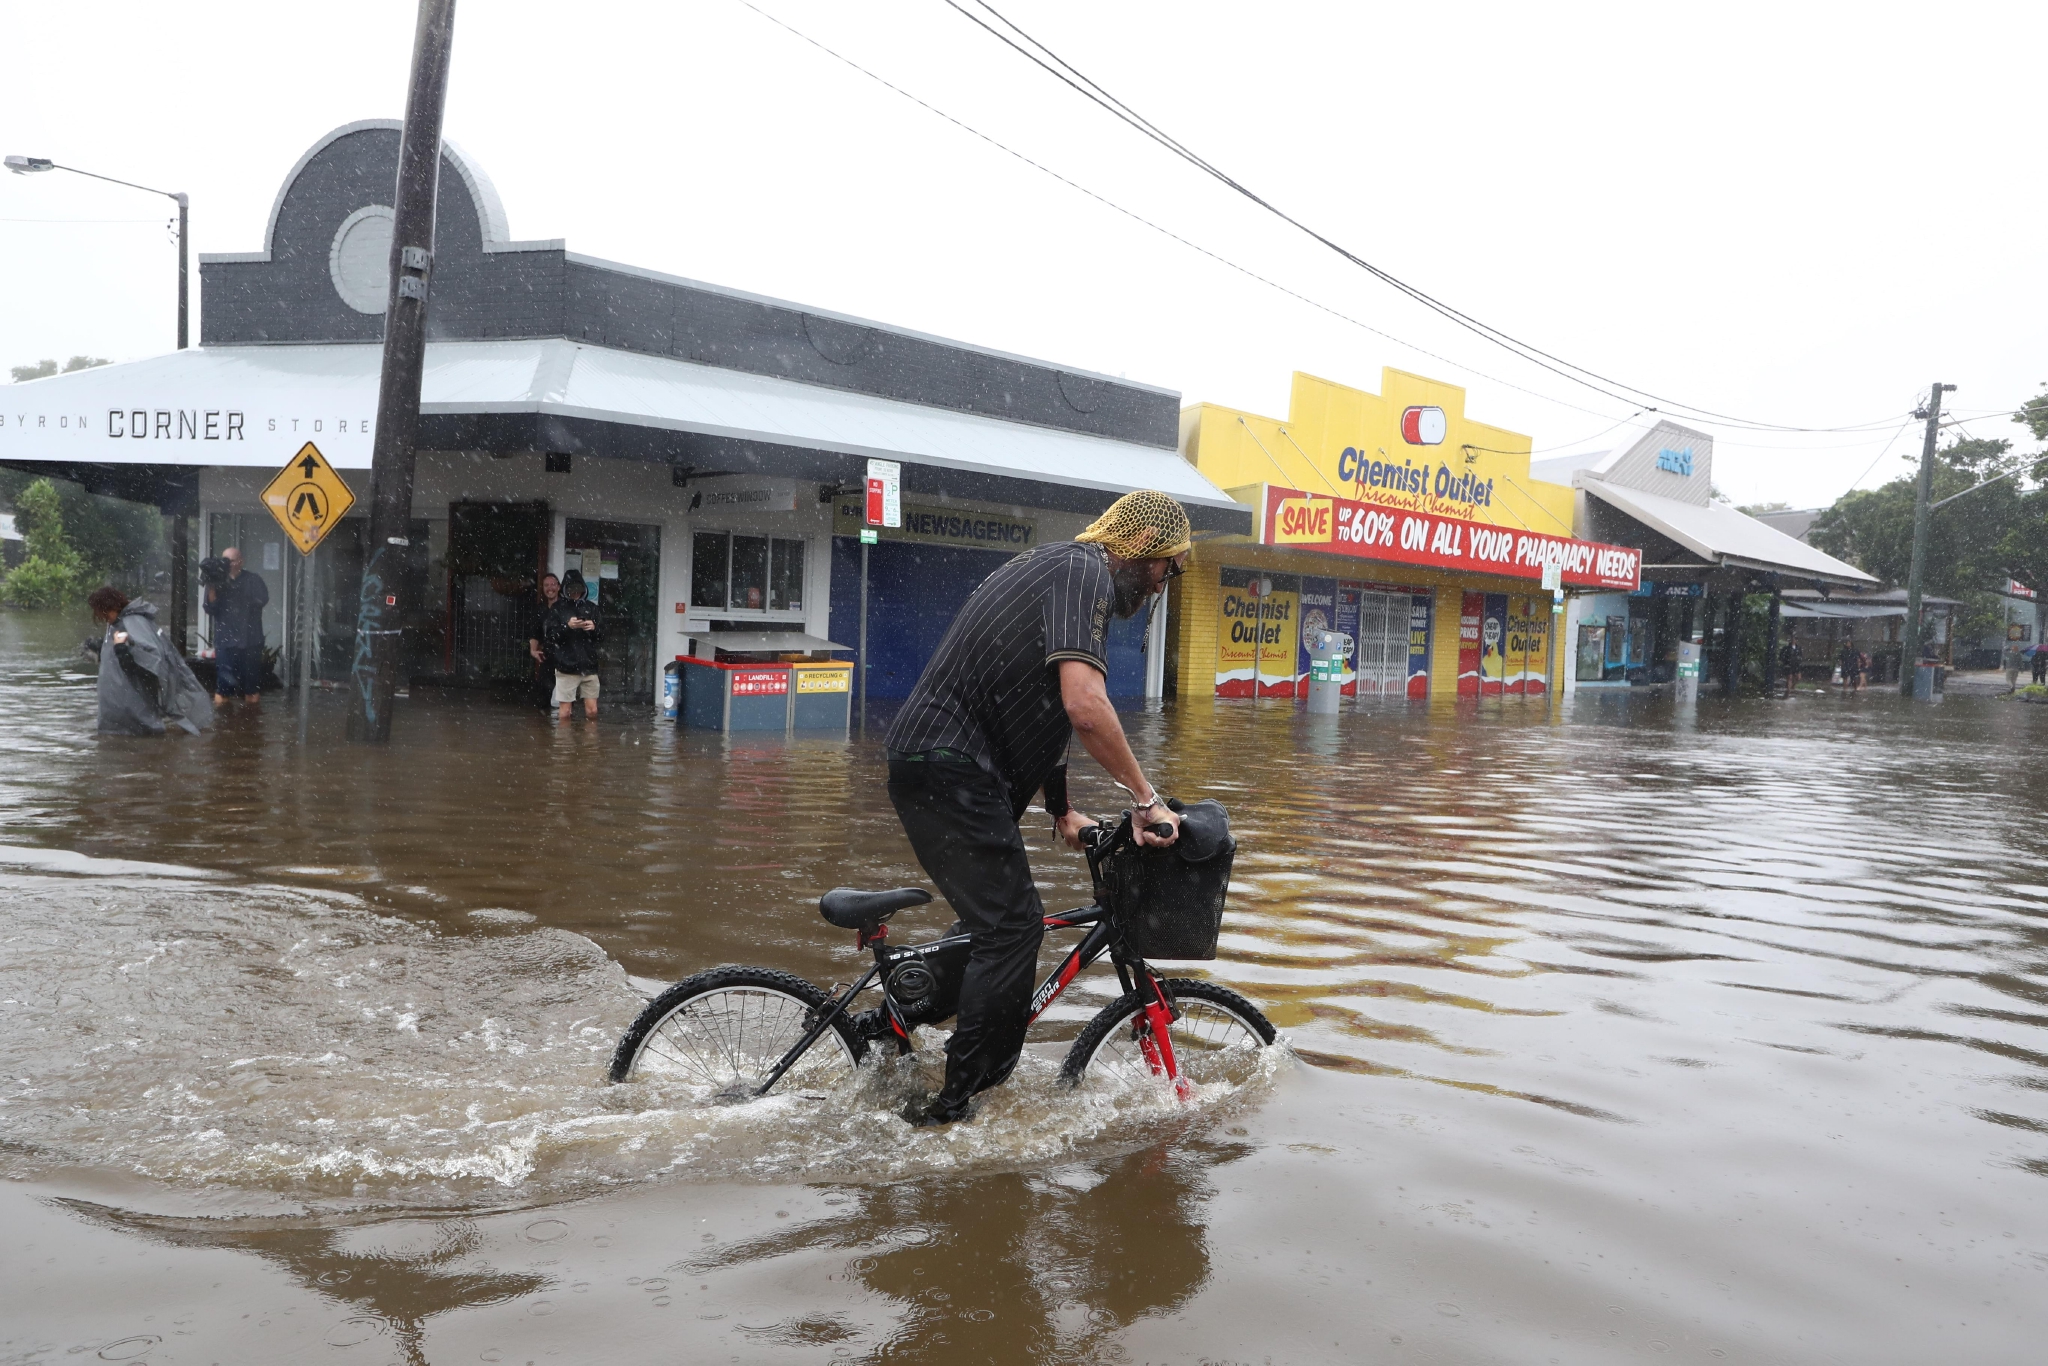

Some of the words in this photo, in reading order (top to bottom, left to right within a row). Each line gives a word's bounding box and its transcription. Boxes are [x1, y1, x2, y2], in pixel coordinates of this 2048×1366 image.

[106, 408, 245, 441] CORNER
[267, 418, 370, 434] STORE
[1338, 446, 1430, 495] Chemist
[1434, 466, 1493, 507] Outlet
[706, 491, 737, 505] COFFEE
[737, 488, 772, 503] WINDOW
[1354, 478, 1421, 511] Discount
[1423, 491, 1475, 520] Chemist
[1282, 505, 1330, 536] SAVE
[1338, 506, 1352, 523] UP
[906, 511, 1032, 544] NEWSAGENCY
[1338, 525, 1351, 541] TO
[1350, 508, 1394, 547] 60%
[1400, 516, 1429, 552] ON
[1430, 521, 1462, 557] ALL
[1469, 527, 1513, 564] YOUR
[1515, 536, 1595, 576] PHARMACY
[1665, 586, 1688, 595] ANZ
[1223, 594, 1291, 621] Chemist
[1301, 594, 1333, 606] WELCOME
[1411, 605, 1427, 618] SAVE
[1460, 627, 1478, 639] PRICES
[1507, 615, 1547, 634] Chemist
[1410, 631, 1426, 645] LIVE
[1221, 646, 1256, 659] Discount
[1035, 981, 1061, 1014] STAR
